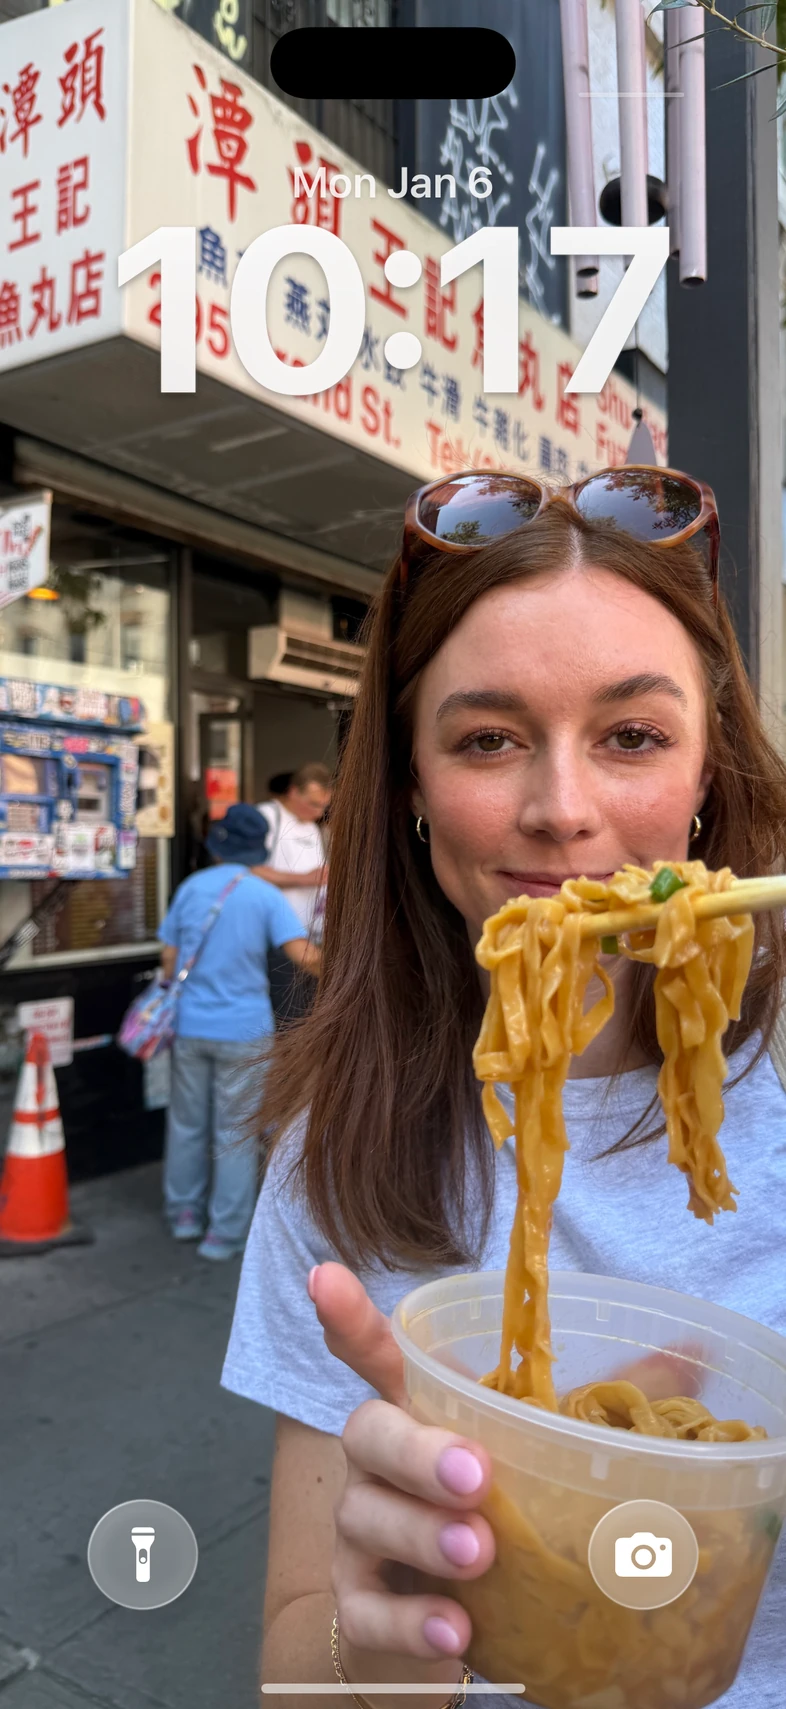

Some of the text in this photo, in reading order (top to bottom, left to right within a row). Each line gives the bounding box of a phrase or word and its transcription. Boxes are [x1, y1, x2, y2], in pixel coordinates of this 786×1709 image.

[0, 27, 106, 158] 潭頭
[7, 156, 91, 252] 王記
[149, 272, 231, 361] 25
[361, 384, 401, 450] St.
